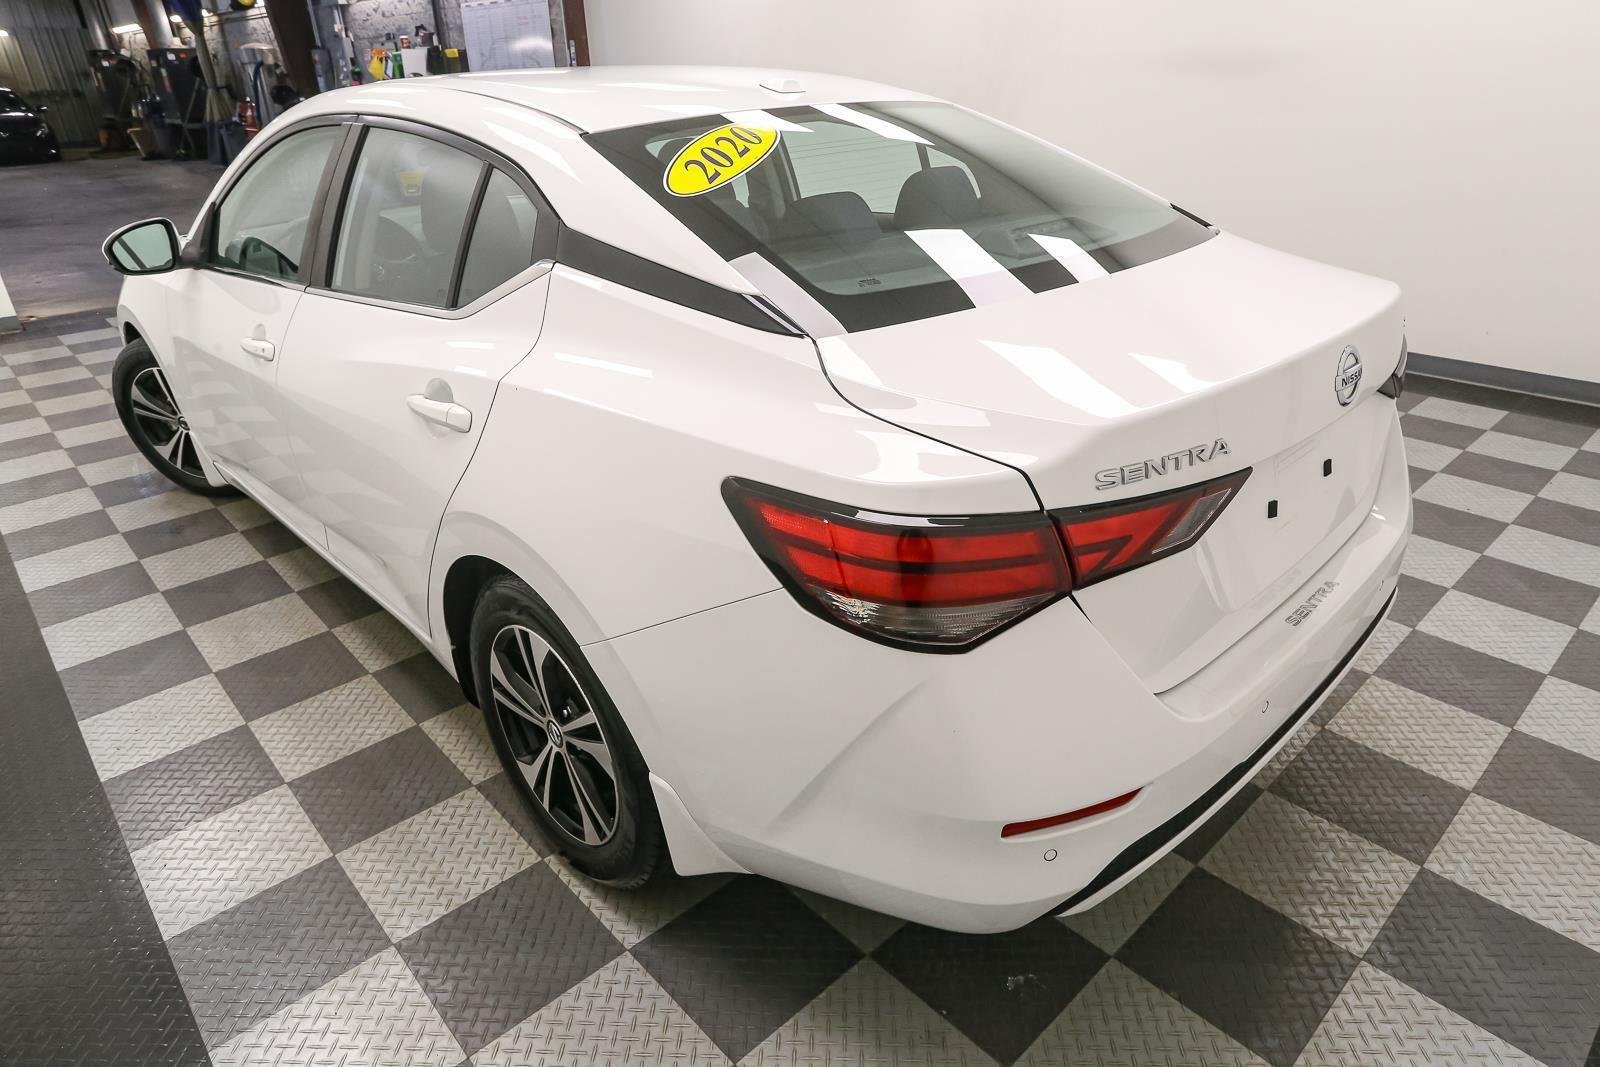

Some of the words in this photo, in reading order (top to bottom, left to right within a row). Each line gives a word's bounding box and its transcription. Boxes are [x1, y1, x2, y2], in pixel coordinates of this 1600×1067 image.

[684, 127, 763, 185] 2020
[1094, 437, 1232, 491] SENTRA
[1284, 581, 1340, 627] SENTRA
